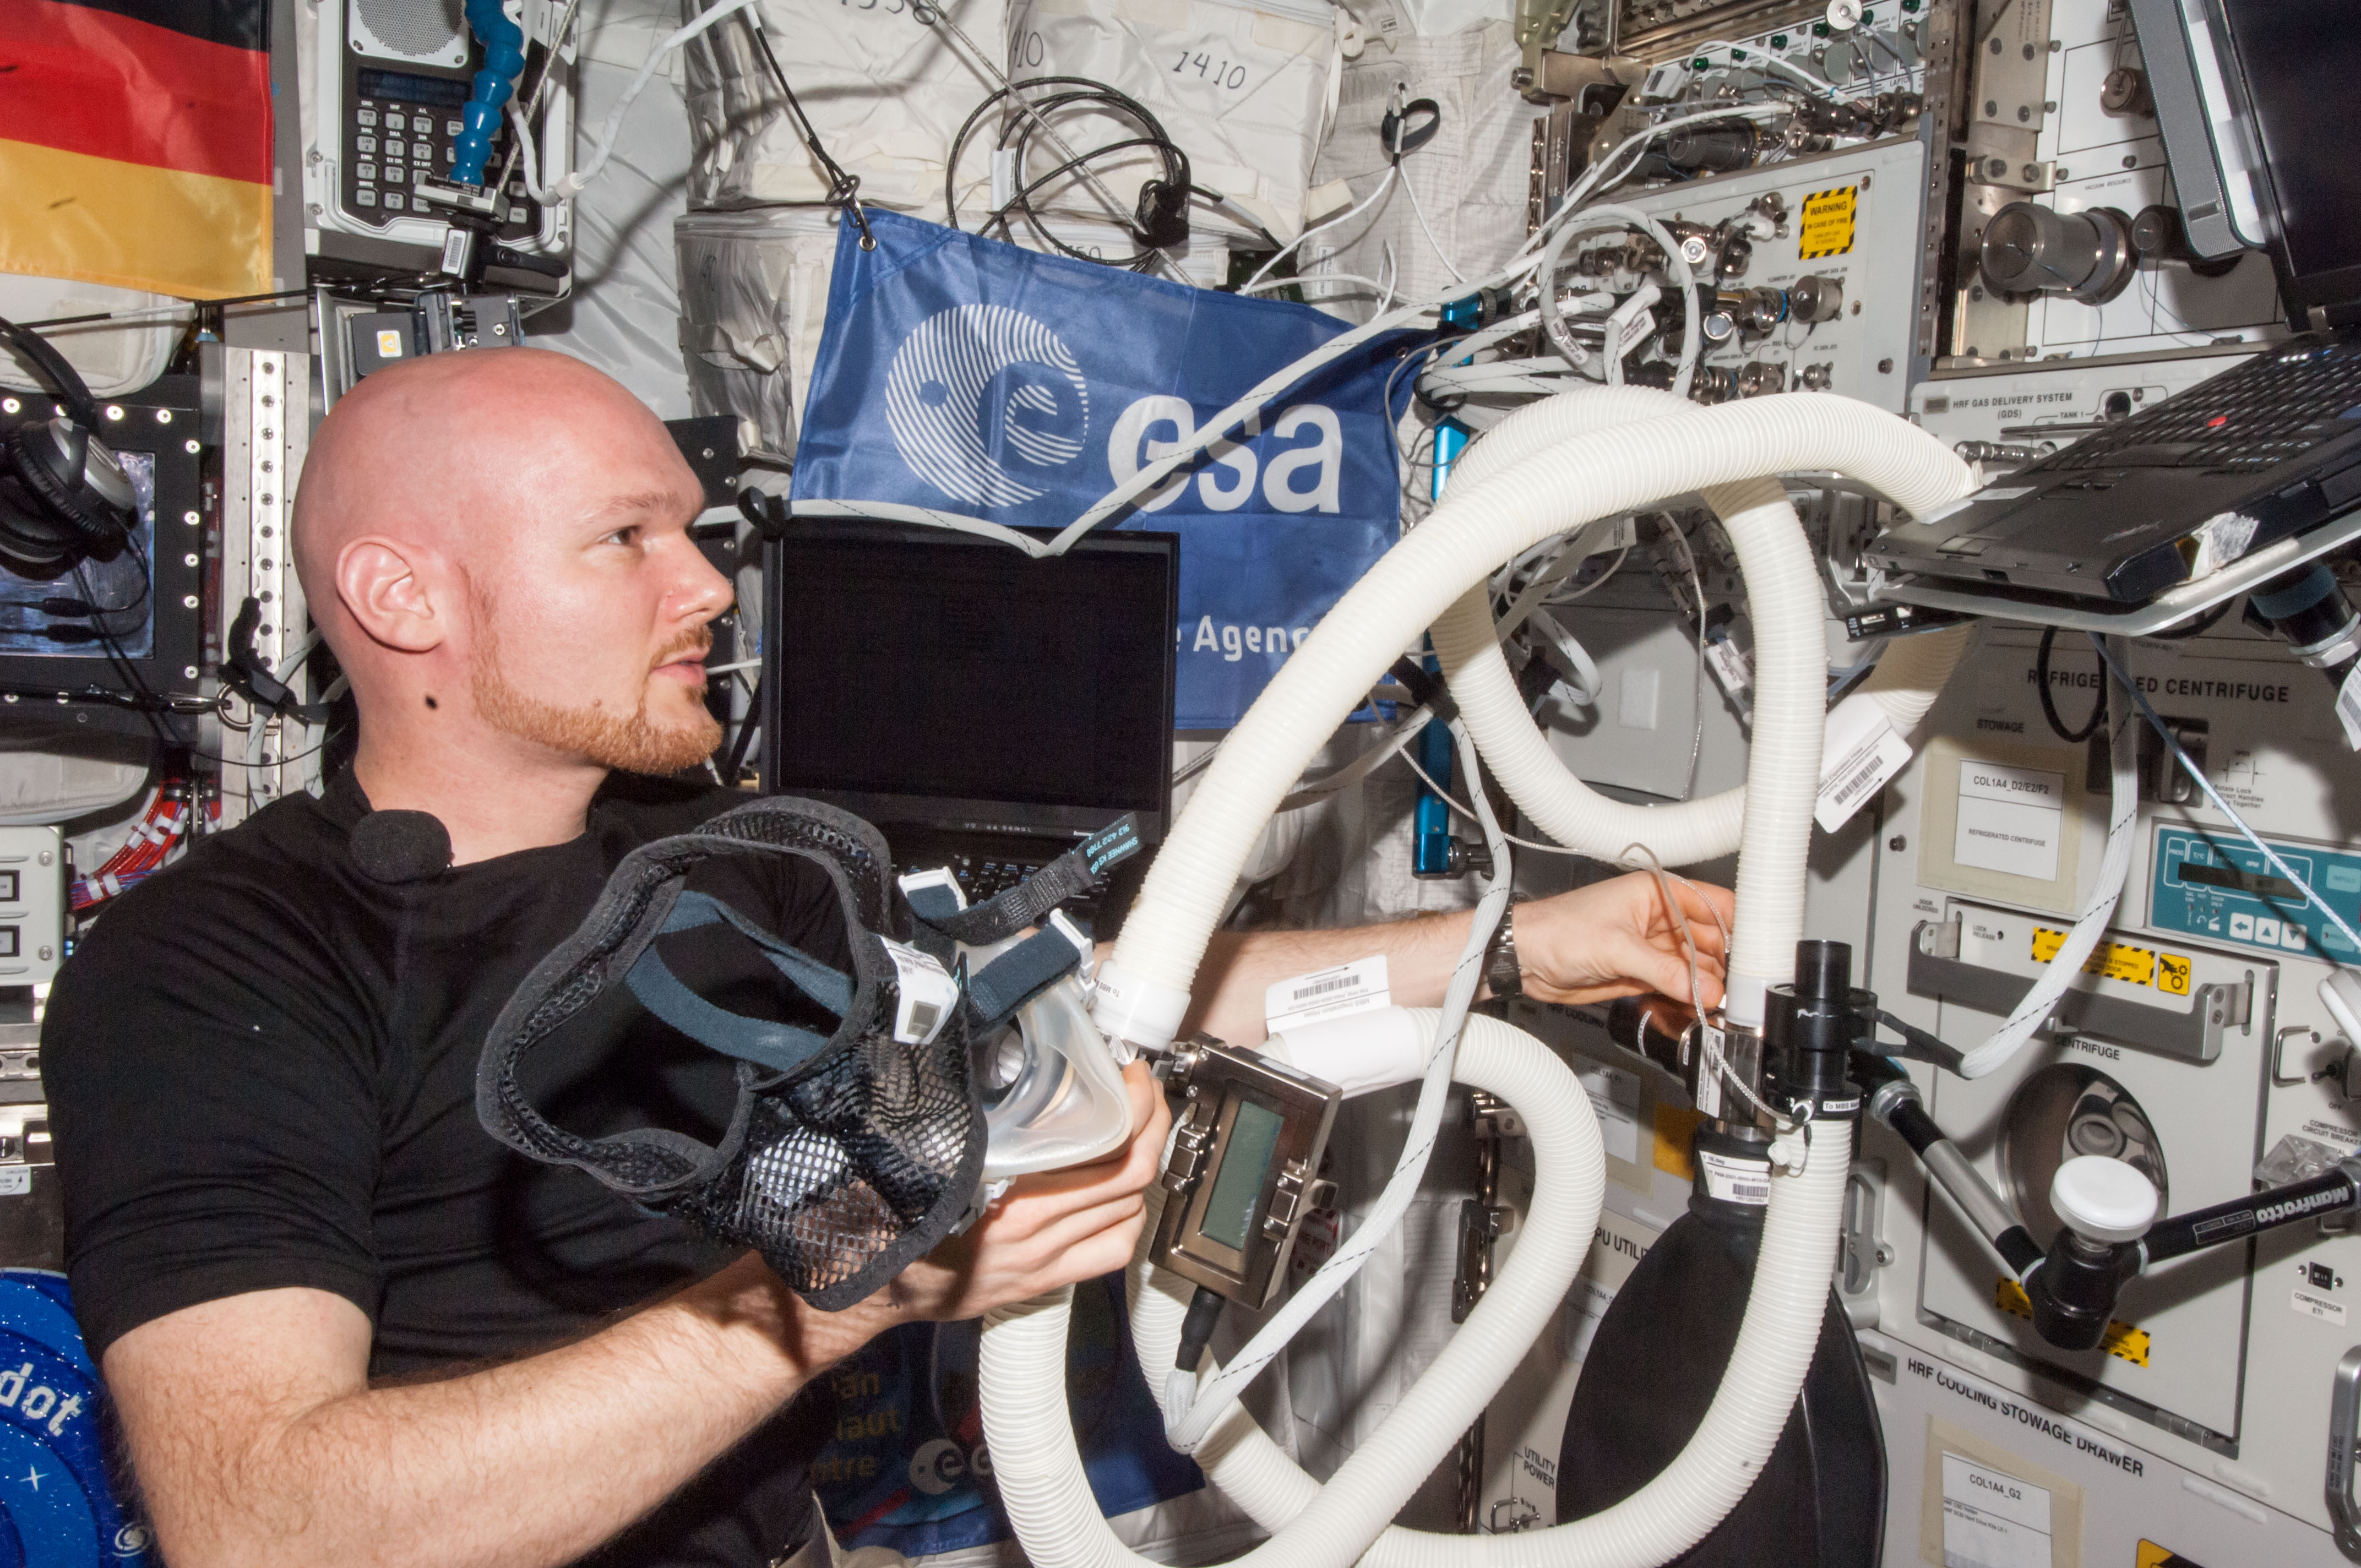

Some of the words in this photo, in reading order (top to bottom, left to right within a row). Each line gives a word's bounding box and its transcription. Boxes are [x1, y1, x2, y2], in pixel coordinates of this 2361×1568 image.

[1172, 51, 1245, 89] 1410
[1810, 201, 1847, 216] WARNING
[1953, 399, 1970, 409] HRF
[1972, 398, 1989, 407] GAS
[1992, 395, 2034, 406] DELIVERY
[2037, 392, 2072, 404] SYSTEM
[1998, 409, 2022, 420] (GDS)
[1108, 394, 1342, 514] esa
[1193, 615, 1310, 662] Agenc
[2166, 678, 2289, 703] CENTRIFUGE
[1977, 718, 2025, 734] STOWAGE
[1973, 775, 2049, 794] COL1A4_D2/E2/F2
[1968, 827, 2010, 841] REFRIGERATED
[2010, 835, 2046, 847] CENTRIFUGE
[1913, 904, 1939, 913] UNLOCKED
[1973, 931, 1996, 941] RELEASE
[2055, 1033, 2120, 1060] CENTRIFUGE
[1835, 1102, 1849, 1110] MBS
[2302, 1125, 2329, 1138] CIRCUIT
[2309, 1119, 2359, 1138] COMPRESSOR
[2256, 1186, 2349, 1223] Manfrotto
[2294, 1292, 2343, 1314] COMPRESSOR
[2313, 1306, 2323, 1316] ETI
[1907, 1358, 1934, 1379] HRF
[1936, 1370, 1998, 1410] COOLING
[2001, 1402, 2072, 1445] STOWAGE
[2076, 1436, 2144, 1478] DRAWER
[1525, 1446, 1555, 1474] UTILITY
[1524, 1460, 1555, 1490] POWER
[1969, 1474, 2022, 1501] COL1A4_G2
